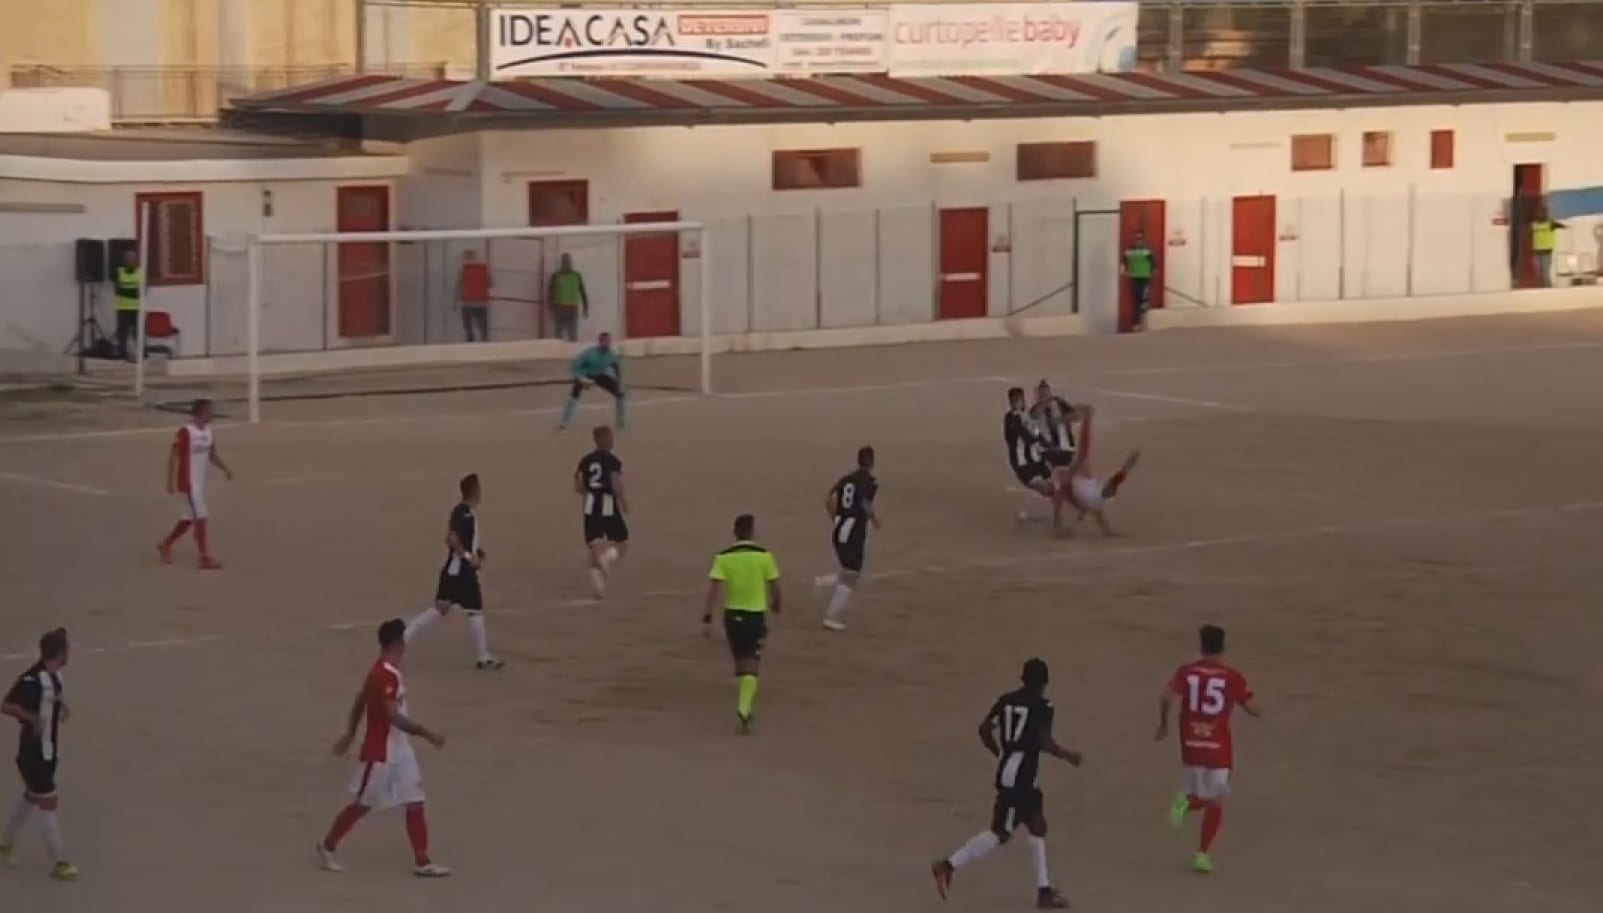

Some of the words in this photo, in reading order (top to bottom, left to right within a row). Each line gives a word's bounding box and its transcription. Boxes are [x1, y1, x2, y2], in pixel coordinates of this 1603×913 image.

[589, 463, 602, 488] 2
[842, 483, 854, 508] 8
[1186, 674, 1226, 715] 15
[1005, 704, 1028, 742] 17
